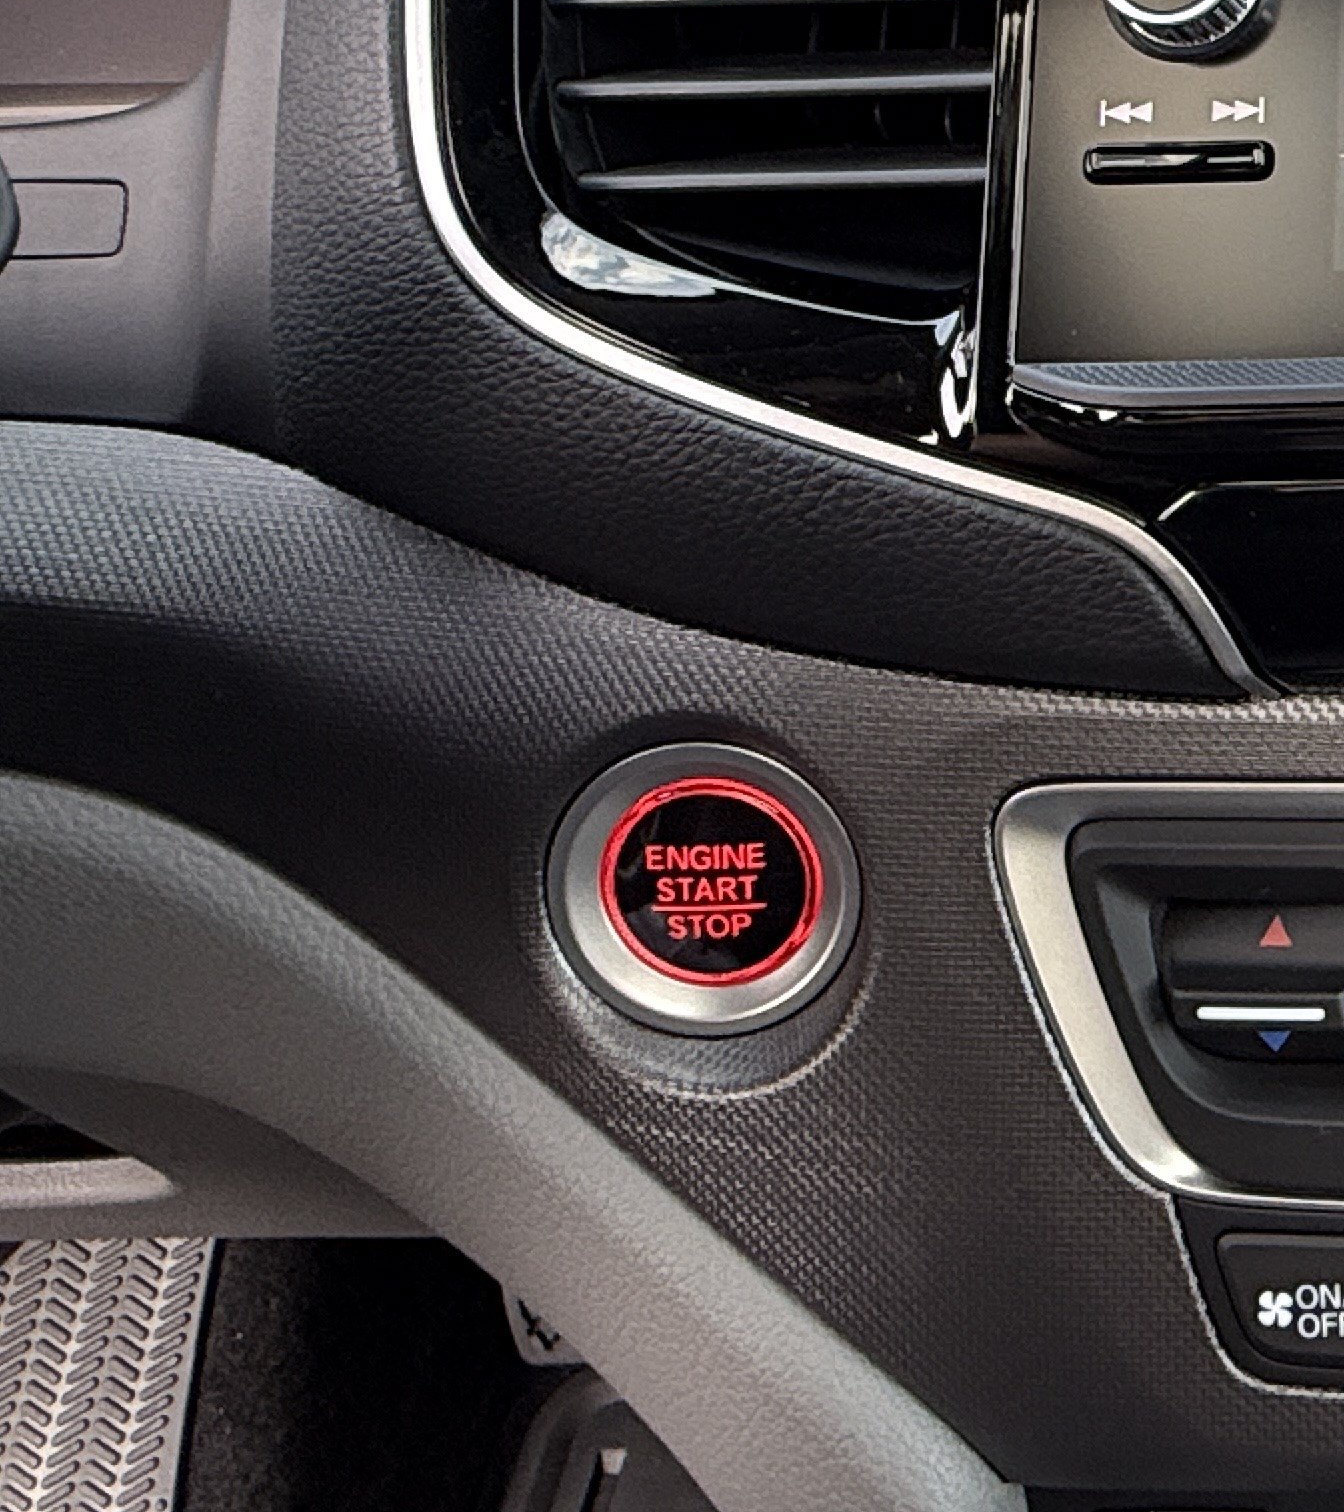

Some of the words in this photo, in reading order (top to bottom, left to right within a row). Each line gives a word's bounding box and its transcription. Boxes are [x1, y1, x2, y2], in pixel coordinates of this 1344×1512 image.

[645, 843, 765, 871] ENGINE
[657, 875, 757, 902] START
[668, 913, 751, 939] STOP
